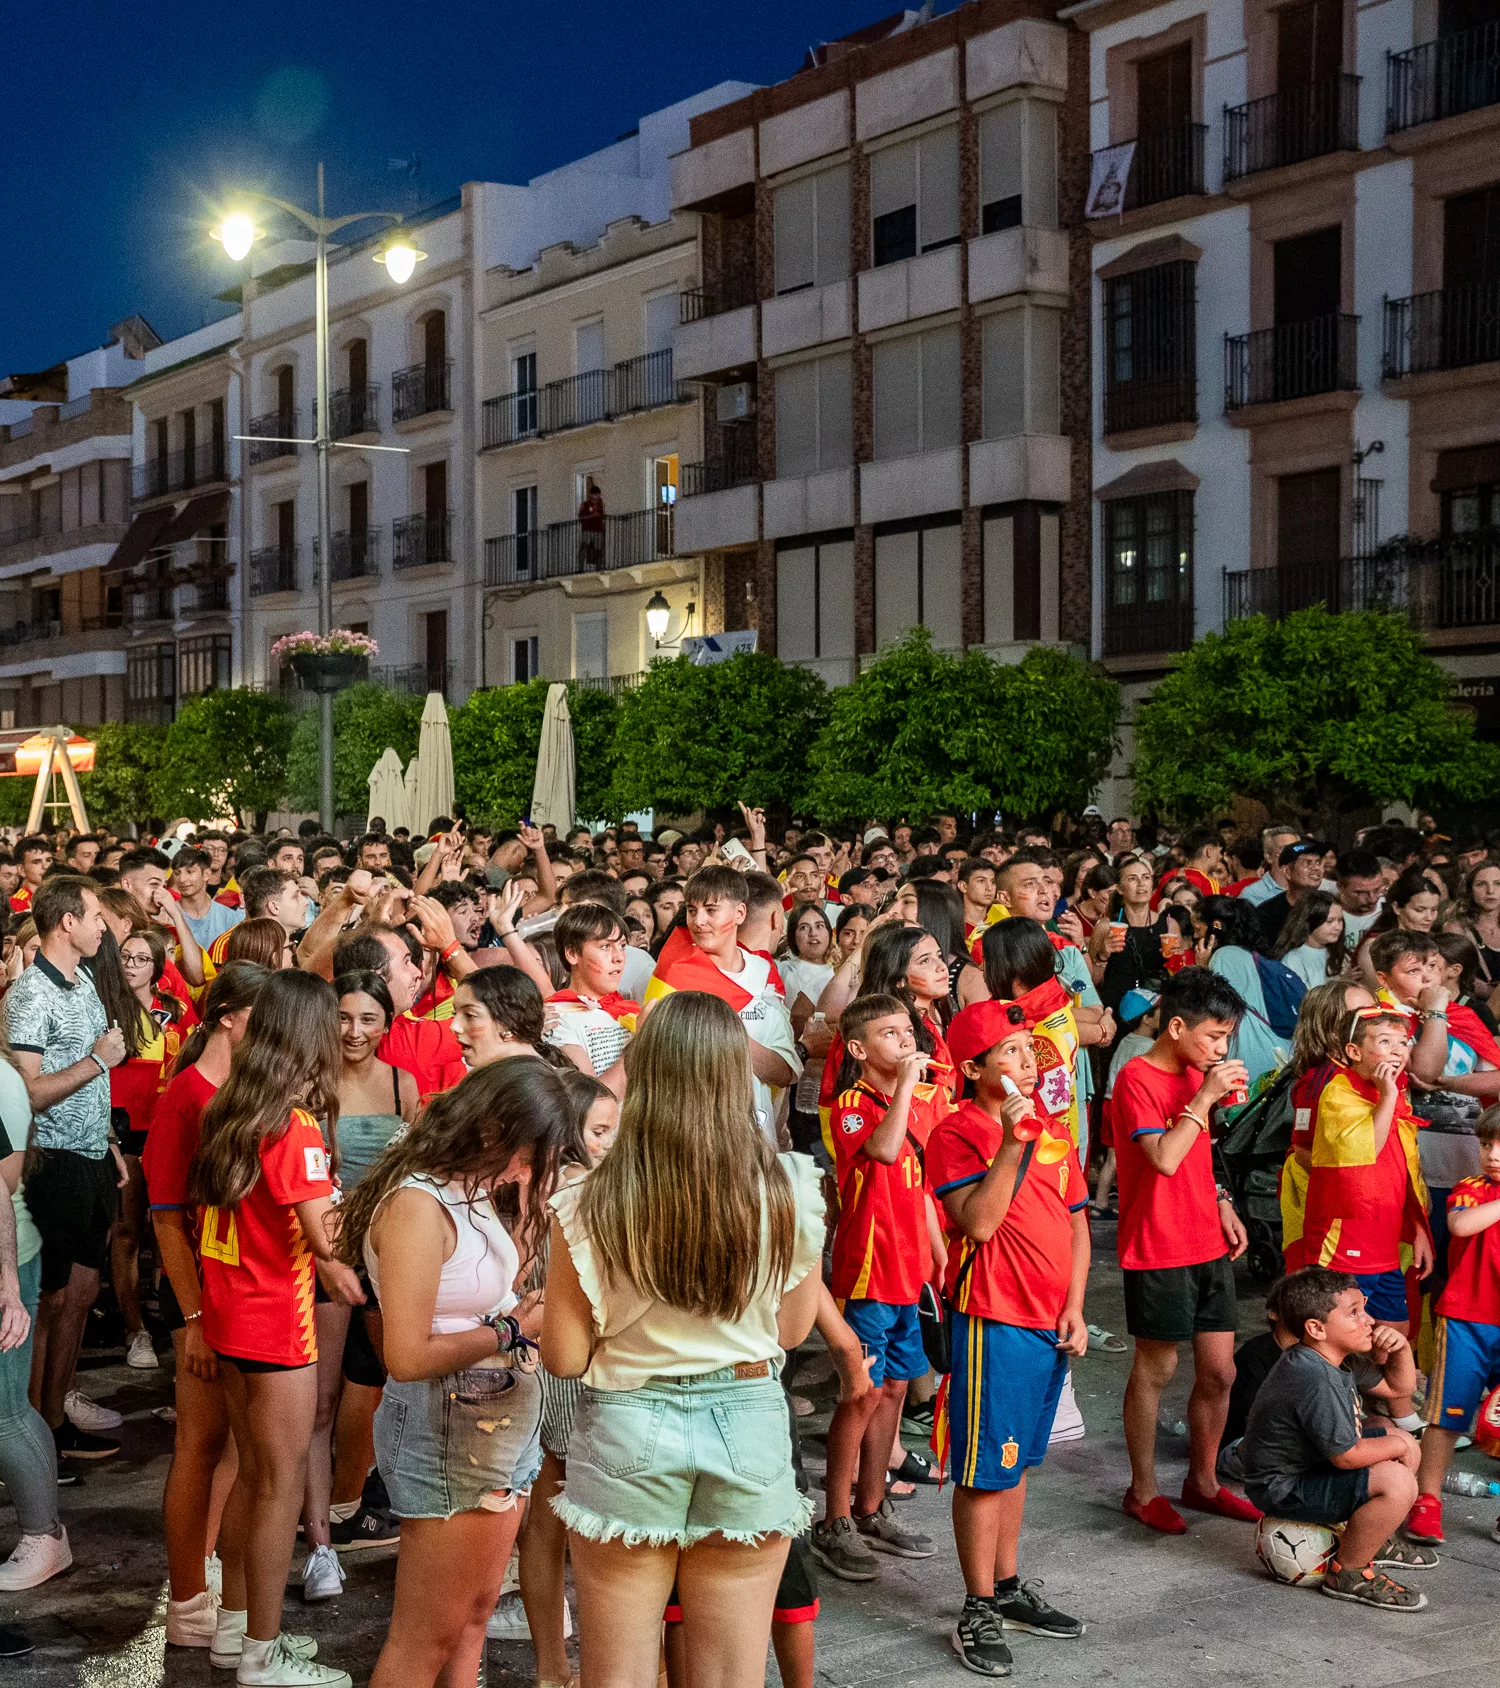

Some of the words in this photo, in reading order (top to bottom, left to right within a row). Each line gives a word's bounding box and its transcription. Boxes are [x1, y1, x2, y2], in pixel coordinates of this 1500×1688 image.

[1448, 682, 1494, 697] alería
[902, 1155, 922, 1189] 19
[737, 1366, 767, 1379] INSIDE
